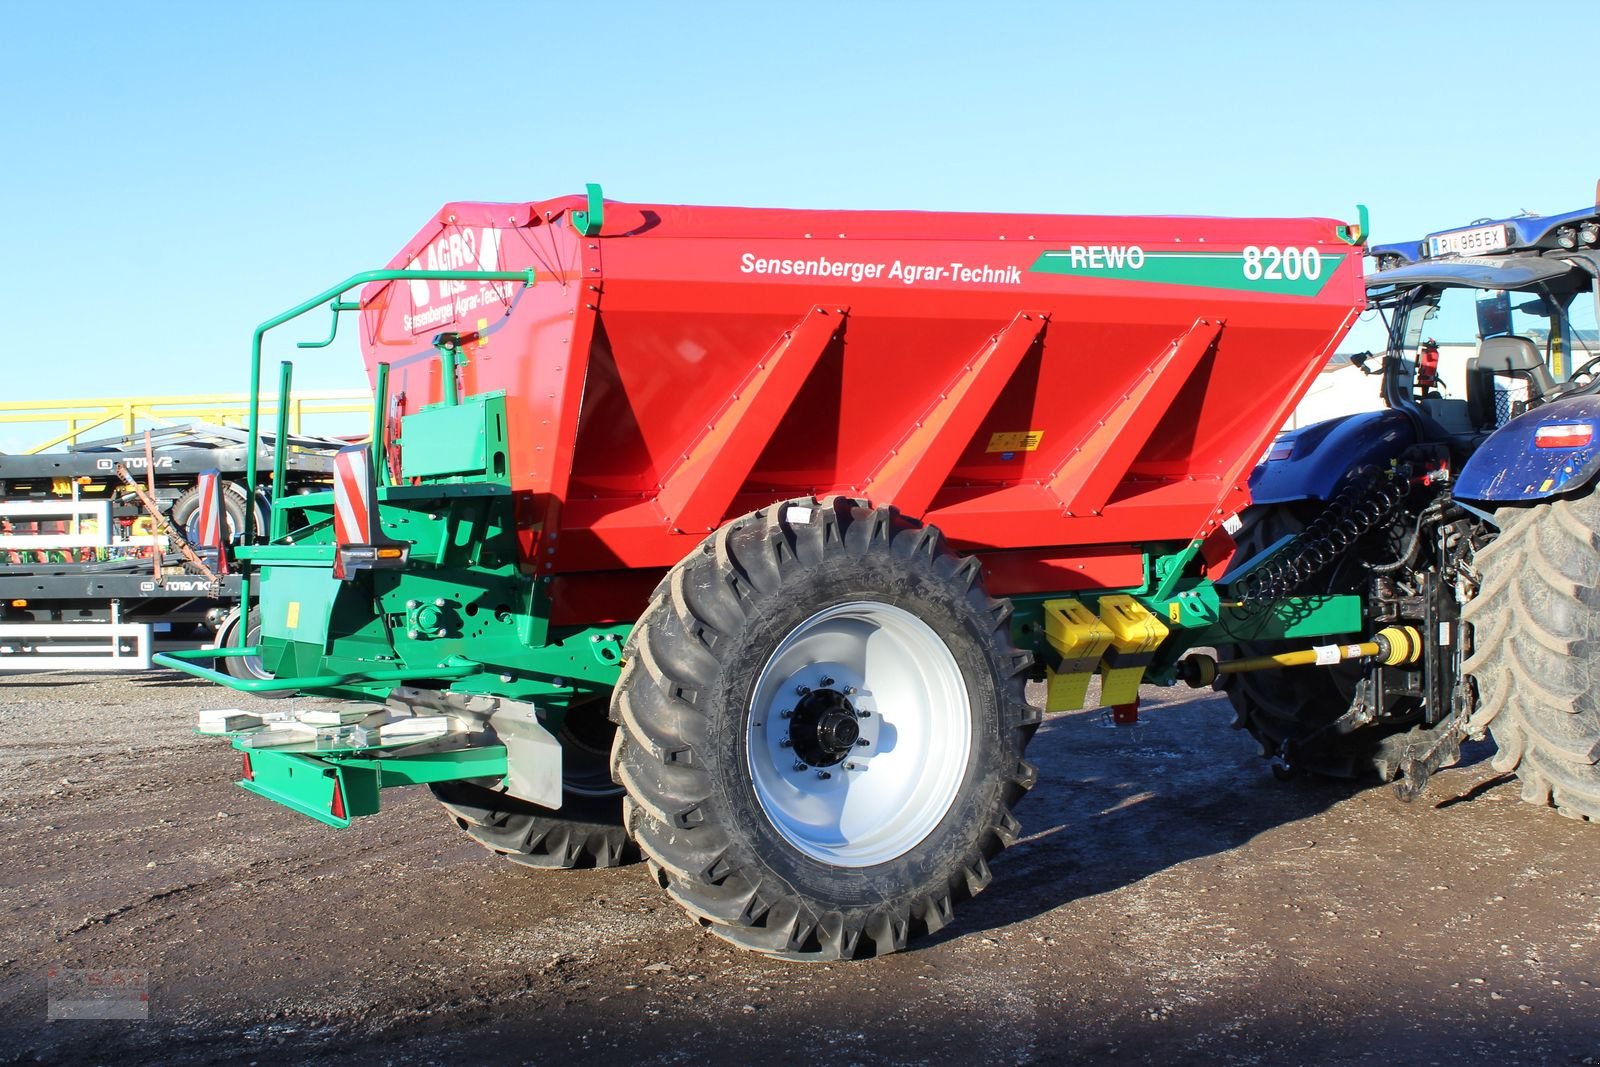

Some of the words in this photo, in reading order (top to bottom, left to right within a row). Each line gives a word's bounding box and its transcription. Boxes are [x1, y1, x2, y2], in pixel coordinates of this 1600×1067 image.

[740, 252, 885, 283] Sensenberger
[888, 259, 1022, 285] Agrar-Technik
[1070, 245, 1146, 270] REWO
[1242, 245, 1322, 281] 8200
[403, 303, 453, 332] Sensenberger
[454, 280, 514, 318] Agrar-Technik
